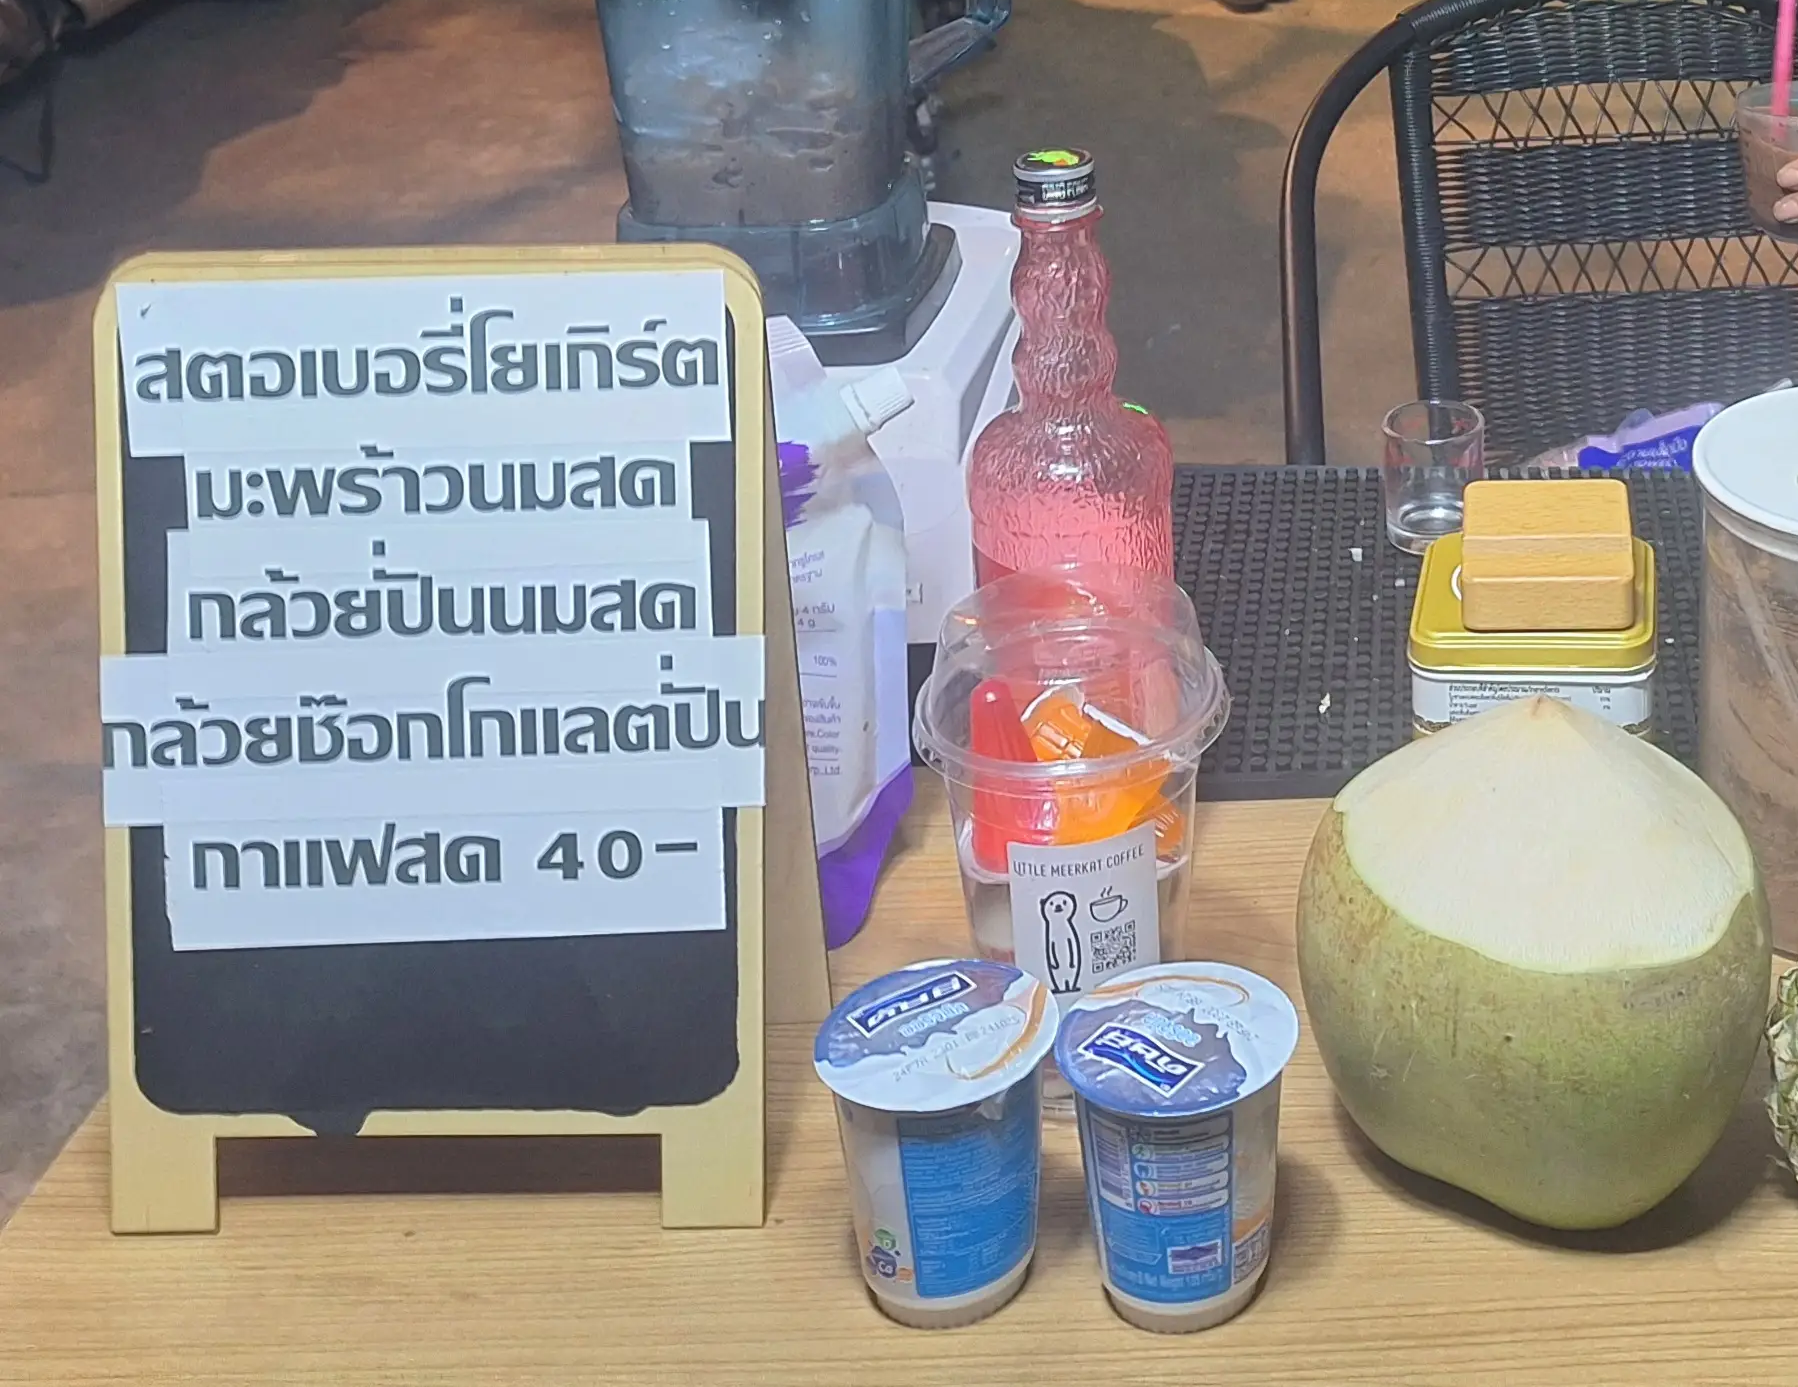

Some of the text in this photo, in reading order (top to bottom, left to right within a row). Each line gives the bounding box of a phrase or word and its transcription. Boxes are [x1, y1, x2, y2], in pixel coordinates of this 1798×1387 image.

[134, 295, 720, 402] สตอเบอรี่โยเกิร์ต
[195, 445, 677, 520] มะพร้าวนมสด
[187, 539, 697, 642] กล้วยปั่นนมสด
[813, 654, 838, 667] 100%
[191, 823, 501, 890] กาแฟสด
[1013, 842, 1146, 878] LITTLE MEERKAT COFFEE
